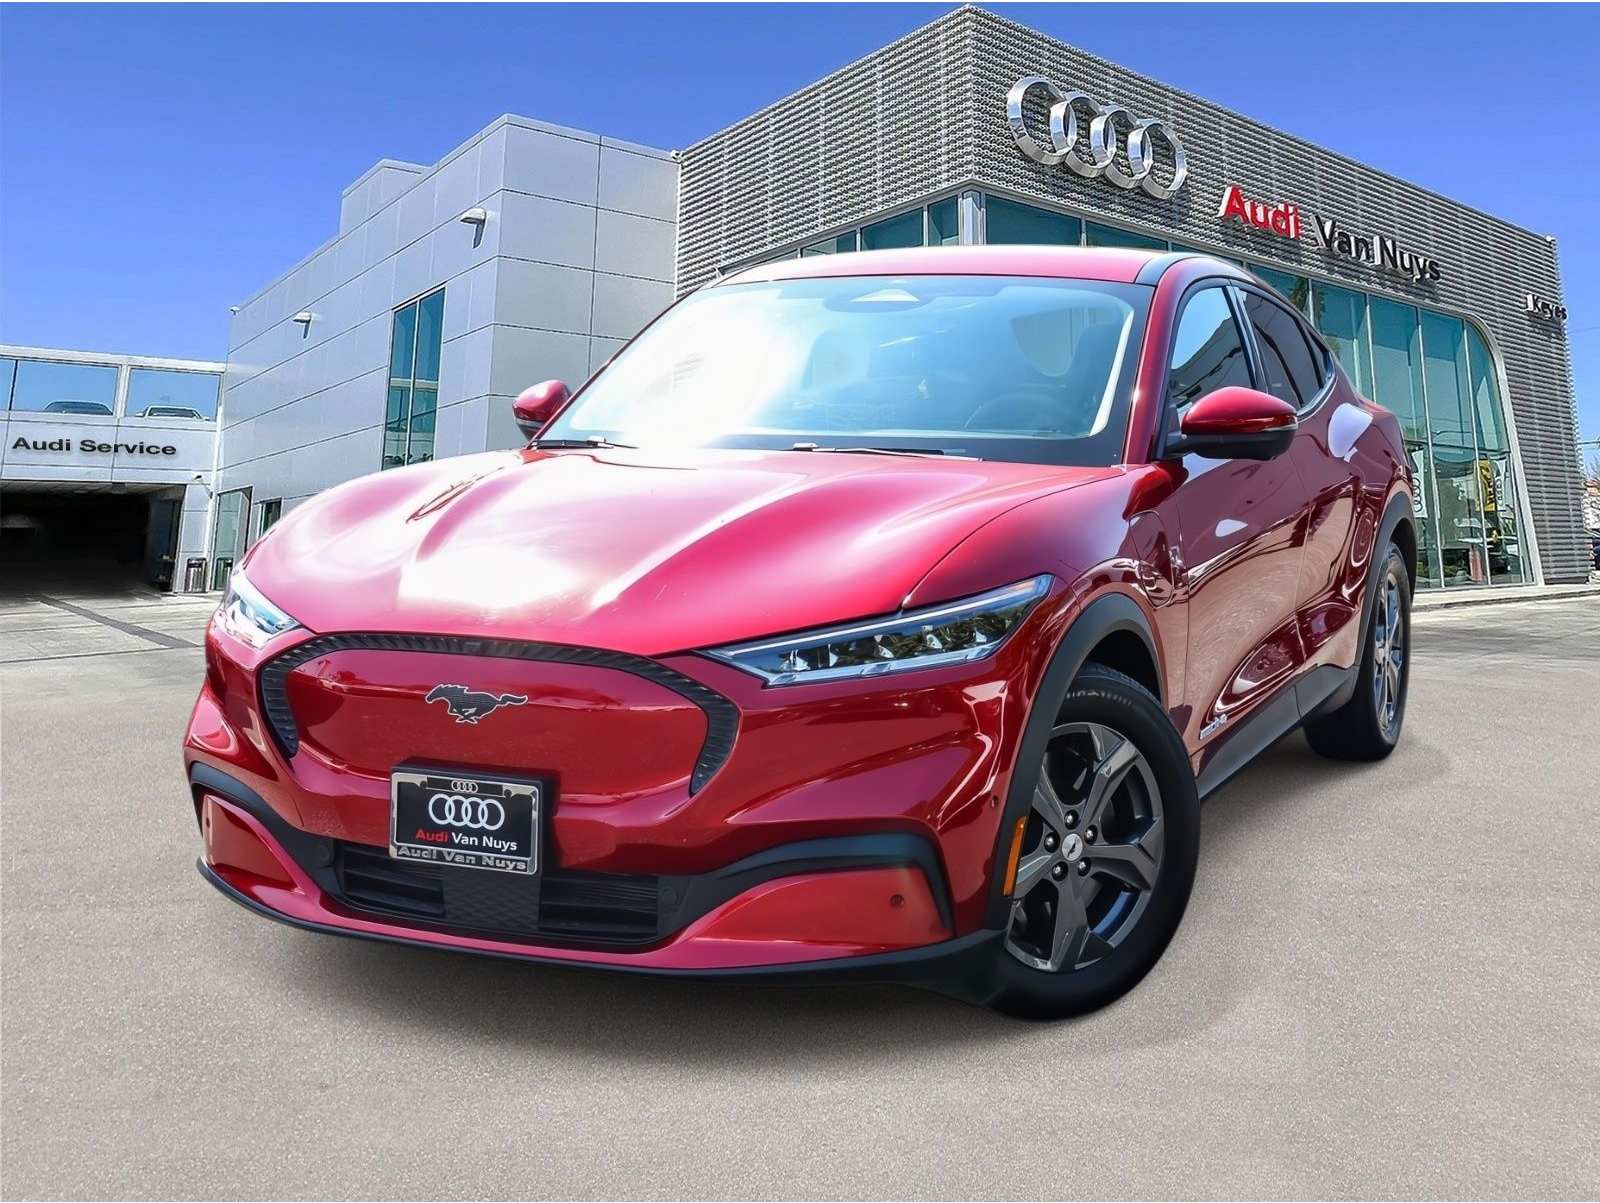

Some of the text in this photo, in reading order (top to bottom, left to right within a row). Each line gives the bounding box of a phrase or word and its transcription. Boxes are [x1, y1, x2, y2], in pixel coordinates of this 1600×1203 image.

[1219, 184, 1442, 282] Audi Van Nuys
[12, 436, 177, 456] Audi Service
[415, 829, 518, 852] Audi Van Nuys
[397, 846, 527, 872] Audi Van Nuys
